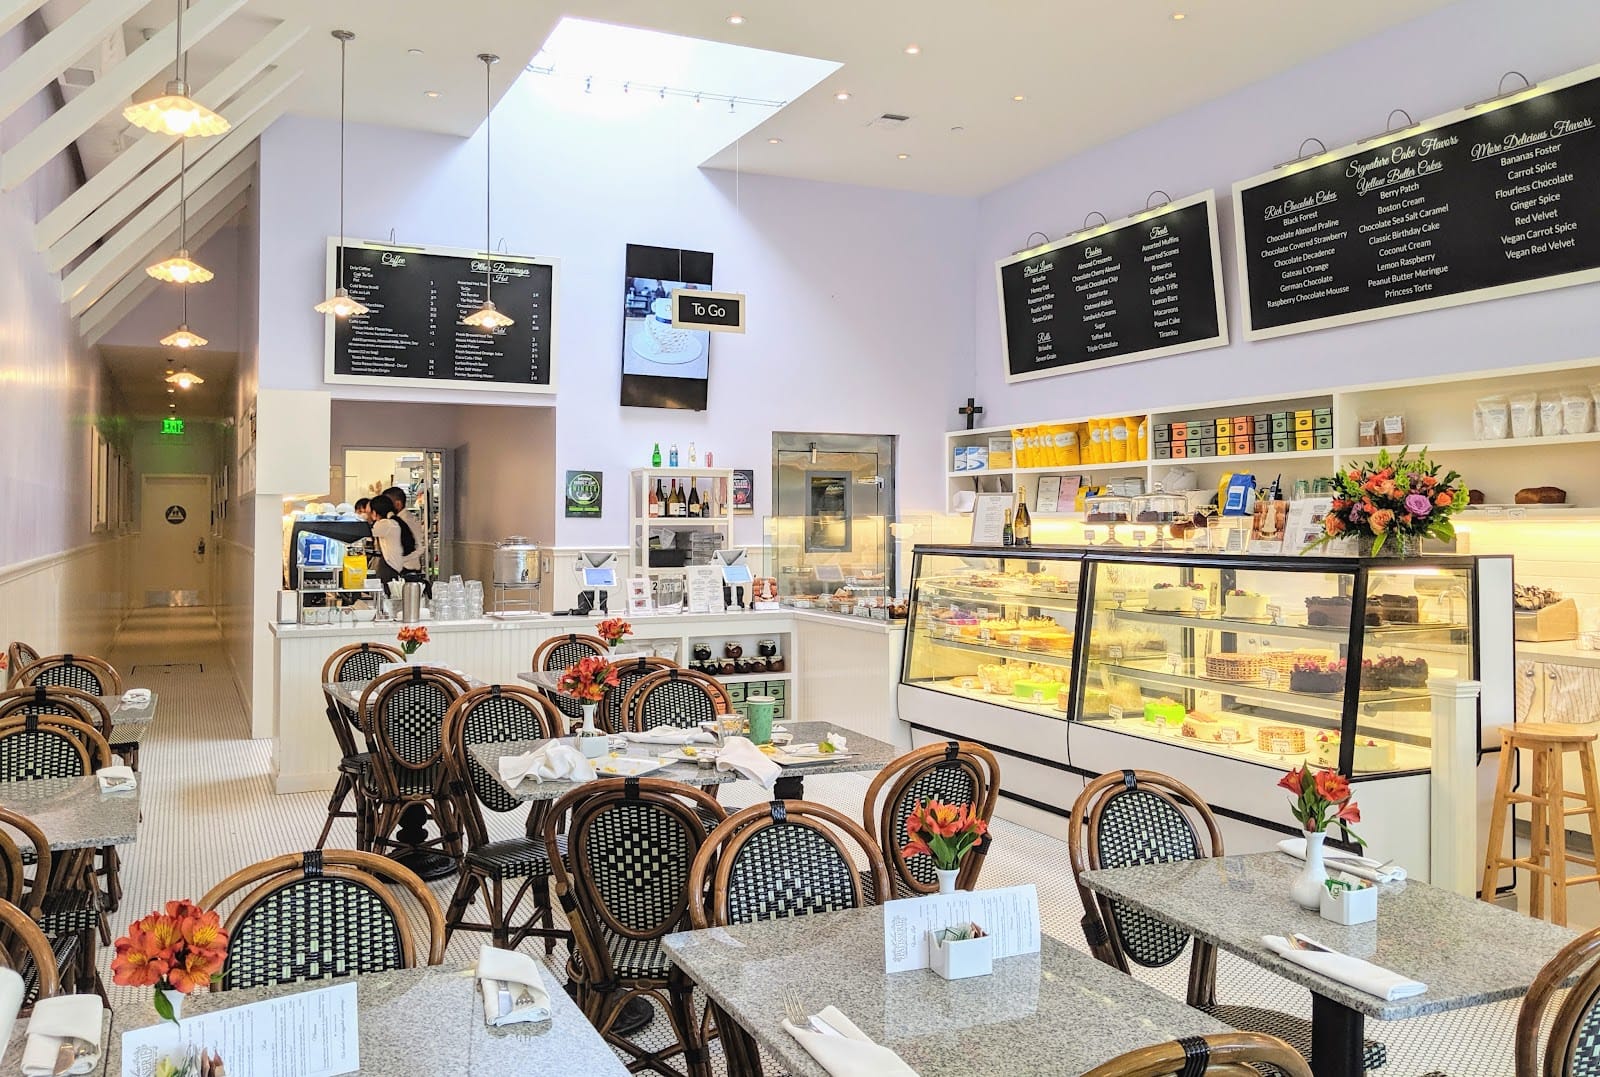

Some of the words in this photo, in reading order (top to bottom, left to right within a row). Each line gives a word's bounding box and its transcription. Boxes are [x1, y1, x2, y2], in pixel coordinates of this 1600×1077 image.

[1471, 142, 1502, 158] More
[1504, 130, 1548, 150] Delicious
[1550, 117, 1593, 138] Flavors
[1346, 157, 1389, 178] Signature
[1392, 146, 1416, 164] Cake
[1418, 136, 1459, 156] Flavors
[1501, 151, 1534, 166] Bananas
[1535, 144, 1561, 157] Foster
[1356, 177, 1385, 196] Yellow
[1387, 167, 1415, 183] Butter
[1418, 160, 1442, 175] Cakes
[1508, 166, 1534, 180] Carrot
[1535, 161, 1557, 174] Spice
[1380, 189, 1399, 199] Berry
[1400, 182, 1419, 194] Patch
[1495, 183, 1531, 199] Flourless
[1531, 173, 1574, 190] Chocolate
[1265, 206, 1282, 218] Rich
[1284, 196, 1314, 214] Chocolate
[1316, 190, 1337, 204] Cakes
[1378, 203, 1401, 214] Boston
[1402, 196, 1425, 207] Cream
[1510, 199, 1537, 211] Ginger
[1538, 193, 1561, 205] Spice
[1283, 216, 1299, 226] Black
[1300, 211, 1318, 221] Forest
[1359, 220, 1391, 233] Chocolate
[1392, 217, 1404, 225] Sea
[1405, 212, 1418, 222] Salt
[1419, 203, 1449, 218] Caramel
[1515, 215, 1530, 226] Red
[1532, 209, 1558, 222] Velvet
[1266, 231, 1294, 243] Chocolate
[1295, 224, 1317, 236] Almond
[1318, 220, 1339, 230] Praline
[1369, 233, 1391, 245] Classic
[1392, 227, 1421, 239] Birthday
[1422, 222, 1440, 232] Cake
[1501, 233, 1526, 244] Vegan
[1526, 226, 1553, 239] Carrot
[1555, 222, 1577, 234] Spice
[1261, 245, 1288, 258] Chocolate
[1289, 239, 1313, 250] Covered
[1314, 231, 1347, 244] Strawberry
[1379, 245, 1407, 256] Coconut
[1408, 240, 1431, 250] Cream
[1505, 248, 1530, 259] Vegan
[1531, 243, 1547, 254] Red
[1548, 238, 1575, 250] Velvet
[381, 252, 406, 267] Coffee
[1274, 255, 1302, 267] Chocolate
[1303, 248, 1335, 260] Decadence
[1377, 261, 1400, 271] Lemon
[1400, 253, 1435, 266] Raspberry
[493, 263, 530, 276] Beverages
[1282, 268, 1302, 278] Gateau
[1303, 263, 1329, 274] L'Orange
[1368, 276, 1391, 287] Peanut
[1392, 273, 1414, 282] Butter
[1415, 265, 1448, 278] Meringue
[1280, 282, 1303, 292] German
[1303, 275, 1333, 287] Chocolate
[1385, 287, 1413, 298] Princess
[1414, 283, 1432, 292] Torte
[1267, 296, 1295, 308] Raspberry
[1296, 289, 1325, 302] Chocolate
[1326, 286, 1349, 296] Mousse
[691, 302, 705, 316] To
[708, 304, 726, 317] Go
[164, 420, 182, 432] EXIT
